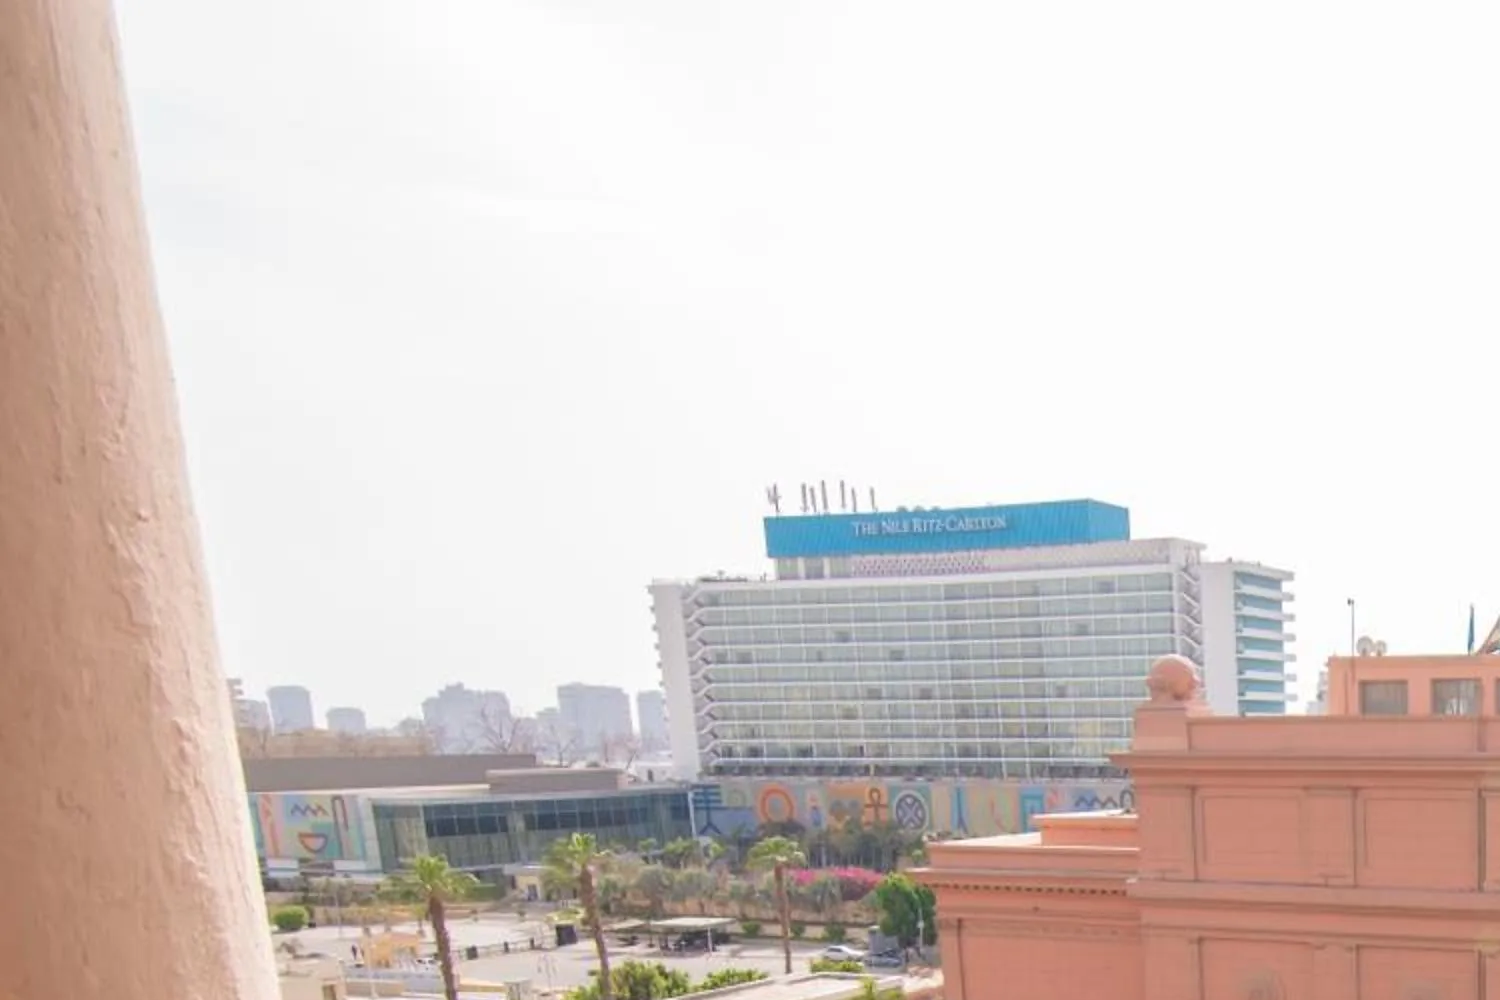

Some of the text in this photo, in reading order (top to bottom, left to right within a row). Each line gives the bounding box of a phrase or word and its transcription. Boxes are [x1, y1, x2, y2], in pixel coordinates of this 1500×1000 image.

[852, 514, 1007, 537] THE NILE RITZ-CARLTON
